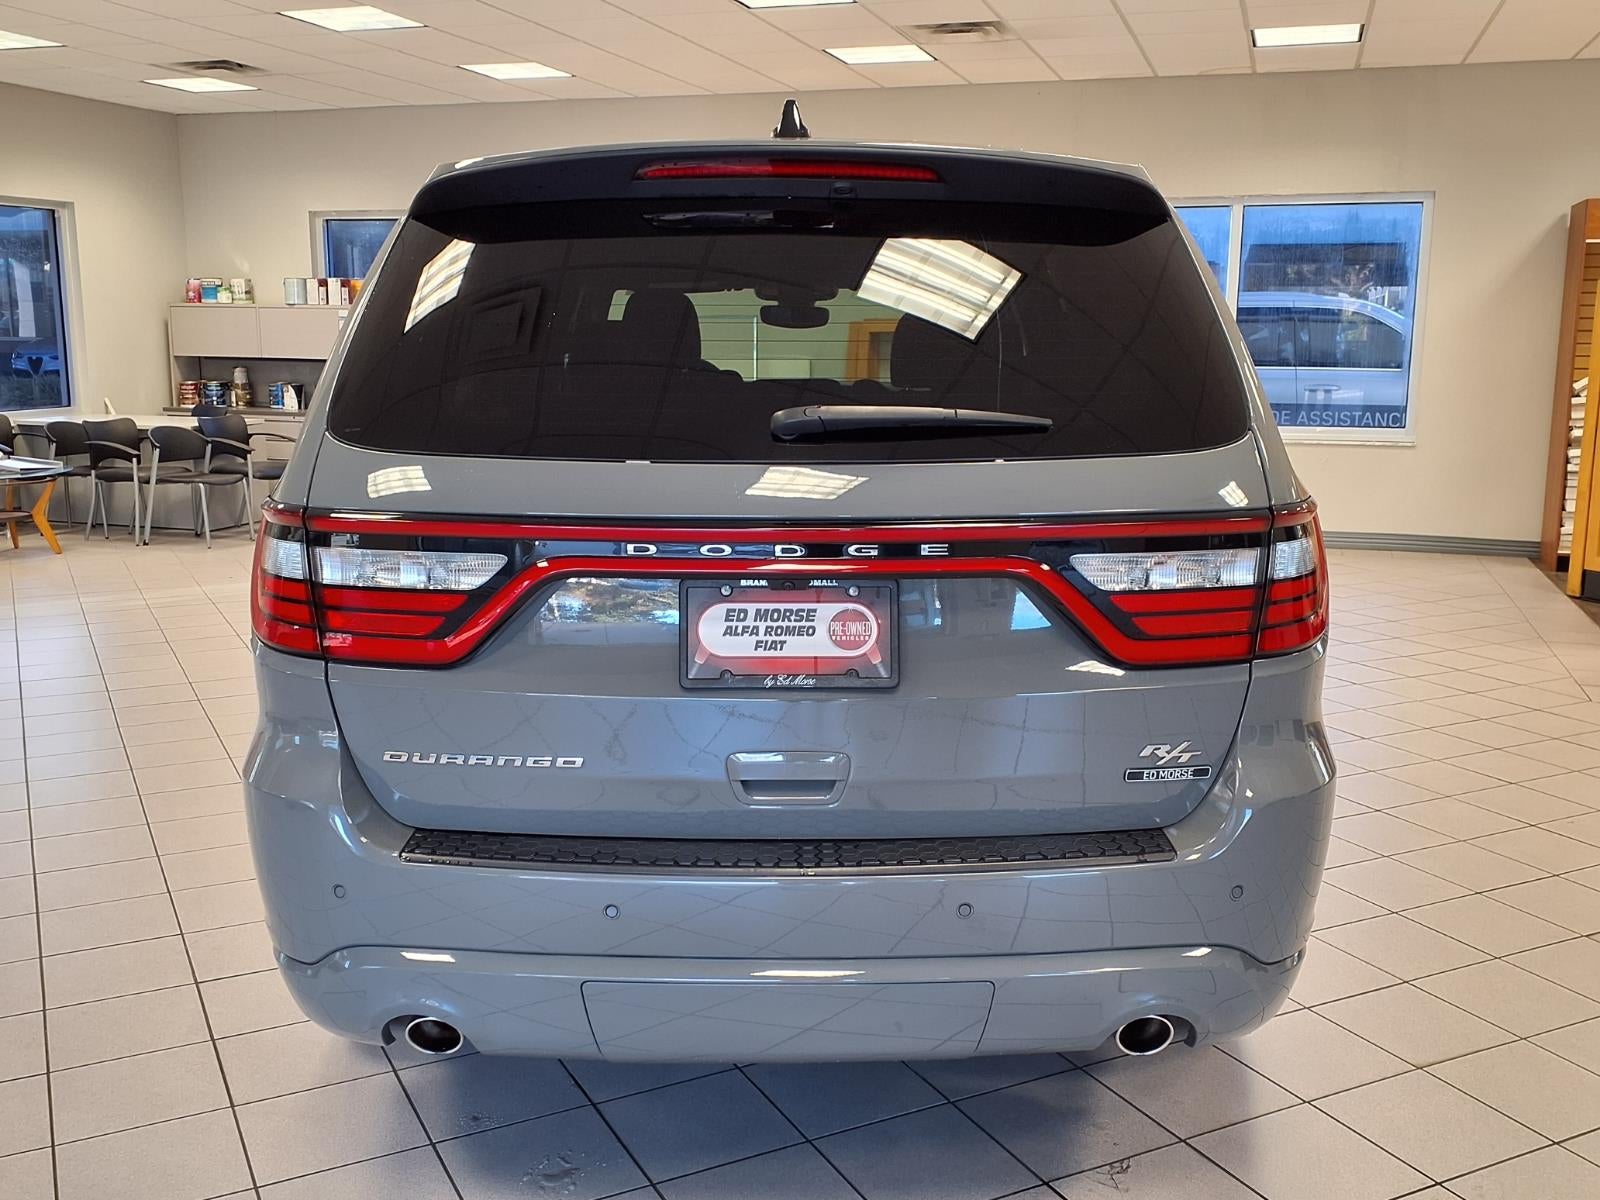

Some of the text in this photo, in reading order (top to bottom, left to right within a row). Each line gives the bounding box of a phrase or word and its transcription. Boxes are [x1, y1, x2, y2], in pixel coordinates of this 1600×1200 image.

[1272, 411, 1291, 425] DE
[626, 543, 949, 557] DODGE
[724, 608, 817, 623] ED MORSE
[722, 625, 816, 637] ALFA ROMEO
[830, 621, 871, 636] PRE-OWNED
[754, 640, 787, 651] FIAT
[763, 674, 816, 689] by Ed Morse
[382, 751, 585, 769] DURANGO
[1139, 741, 1202, 765] R/T
[1143, 769, 1194, 780] ED MORSE
